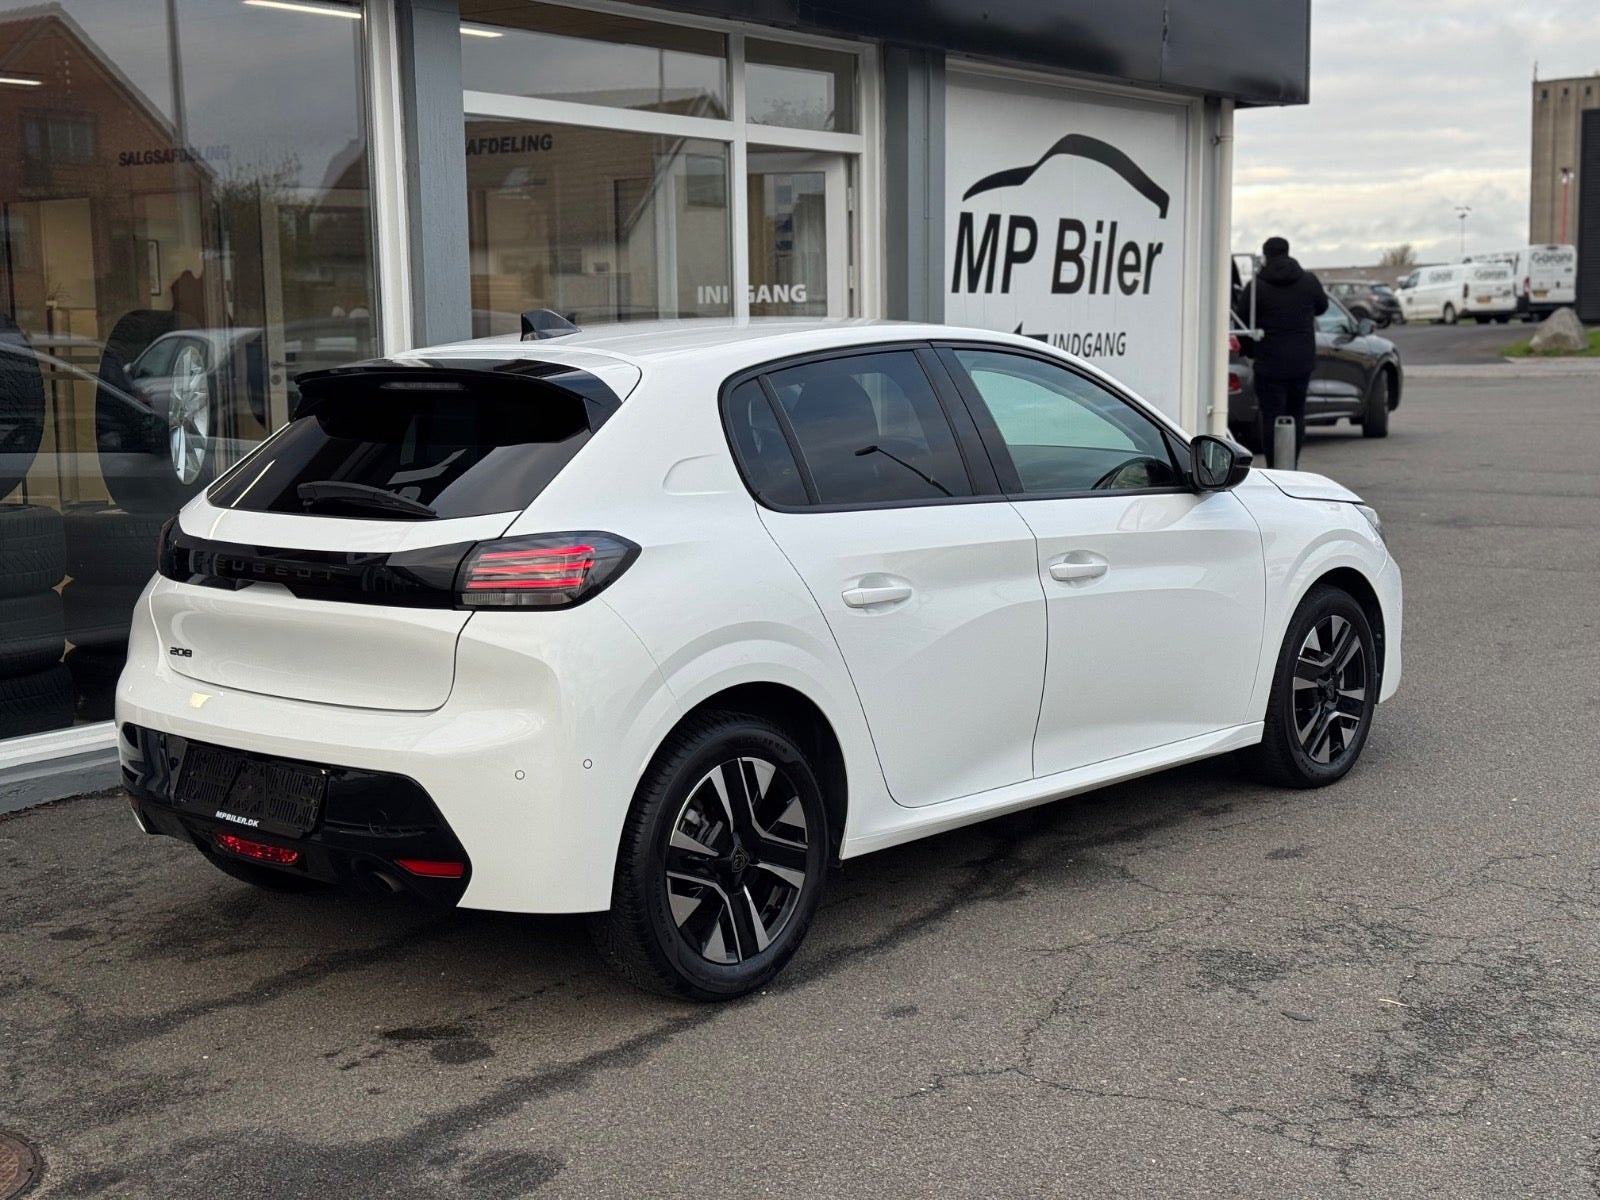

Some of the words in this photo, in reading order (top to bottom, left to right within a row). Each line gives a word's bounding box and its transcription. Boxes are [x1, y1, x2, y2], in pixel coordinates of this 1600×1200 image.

[951, 211, 1039, 294] MP
[1051, 217, 1164, 296] Biler
[170, 646, 193, 658] 208
[215, 810, 260, 828] MPBILER.DK
